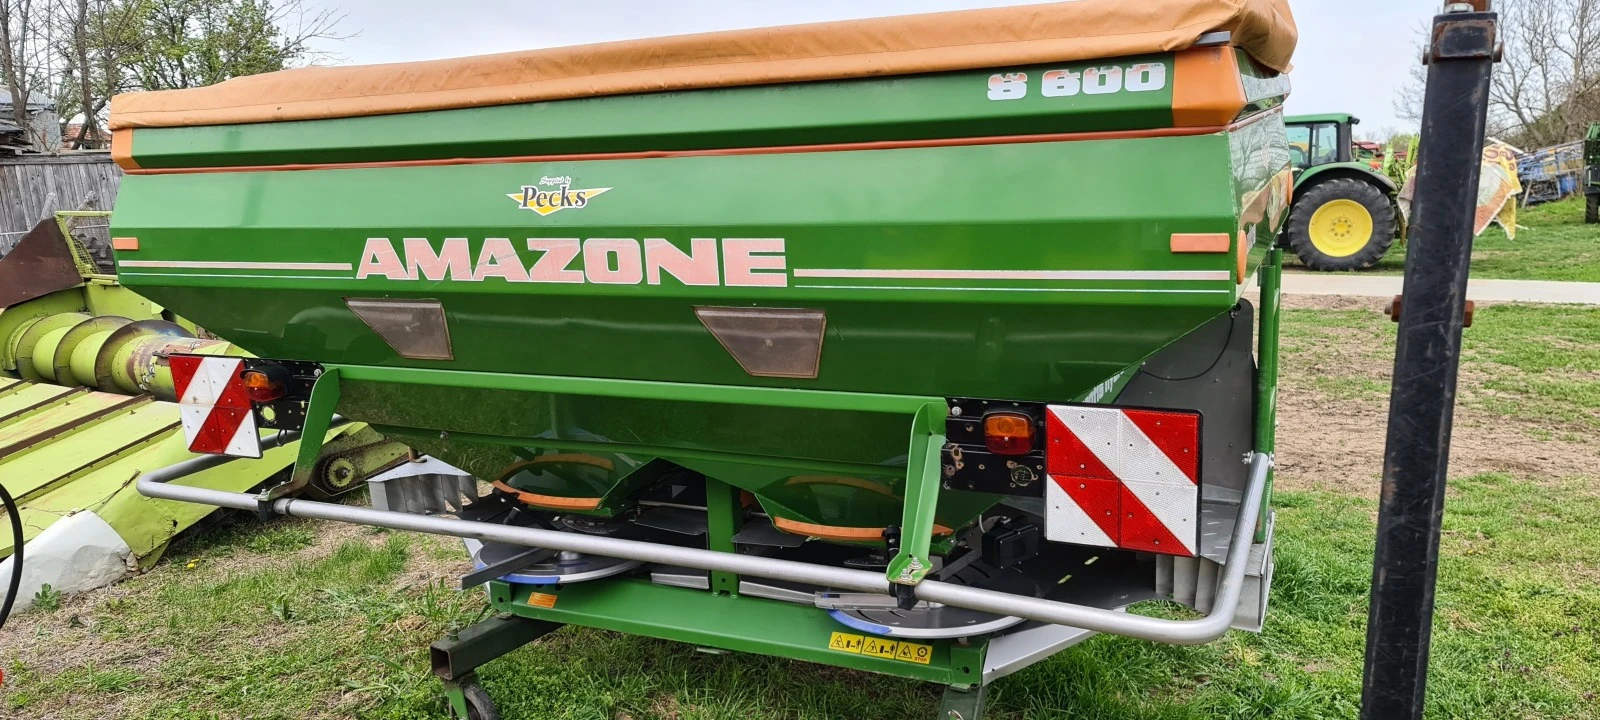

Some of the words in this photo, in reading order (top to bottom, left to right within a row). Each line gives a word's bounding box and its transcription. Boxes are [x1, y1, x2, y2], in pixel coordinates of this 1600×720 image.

[987, 72, 1027, 100] S
[1041, 63, 1166, 97] 600
[520, 185, 587, 208] Pecks
[356, 238, 788, 287] AMAZONE
